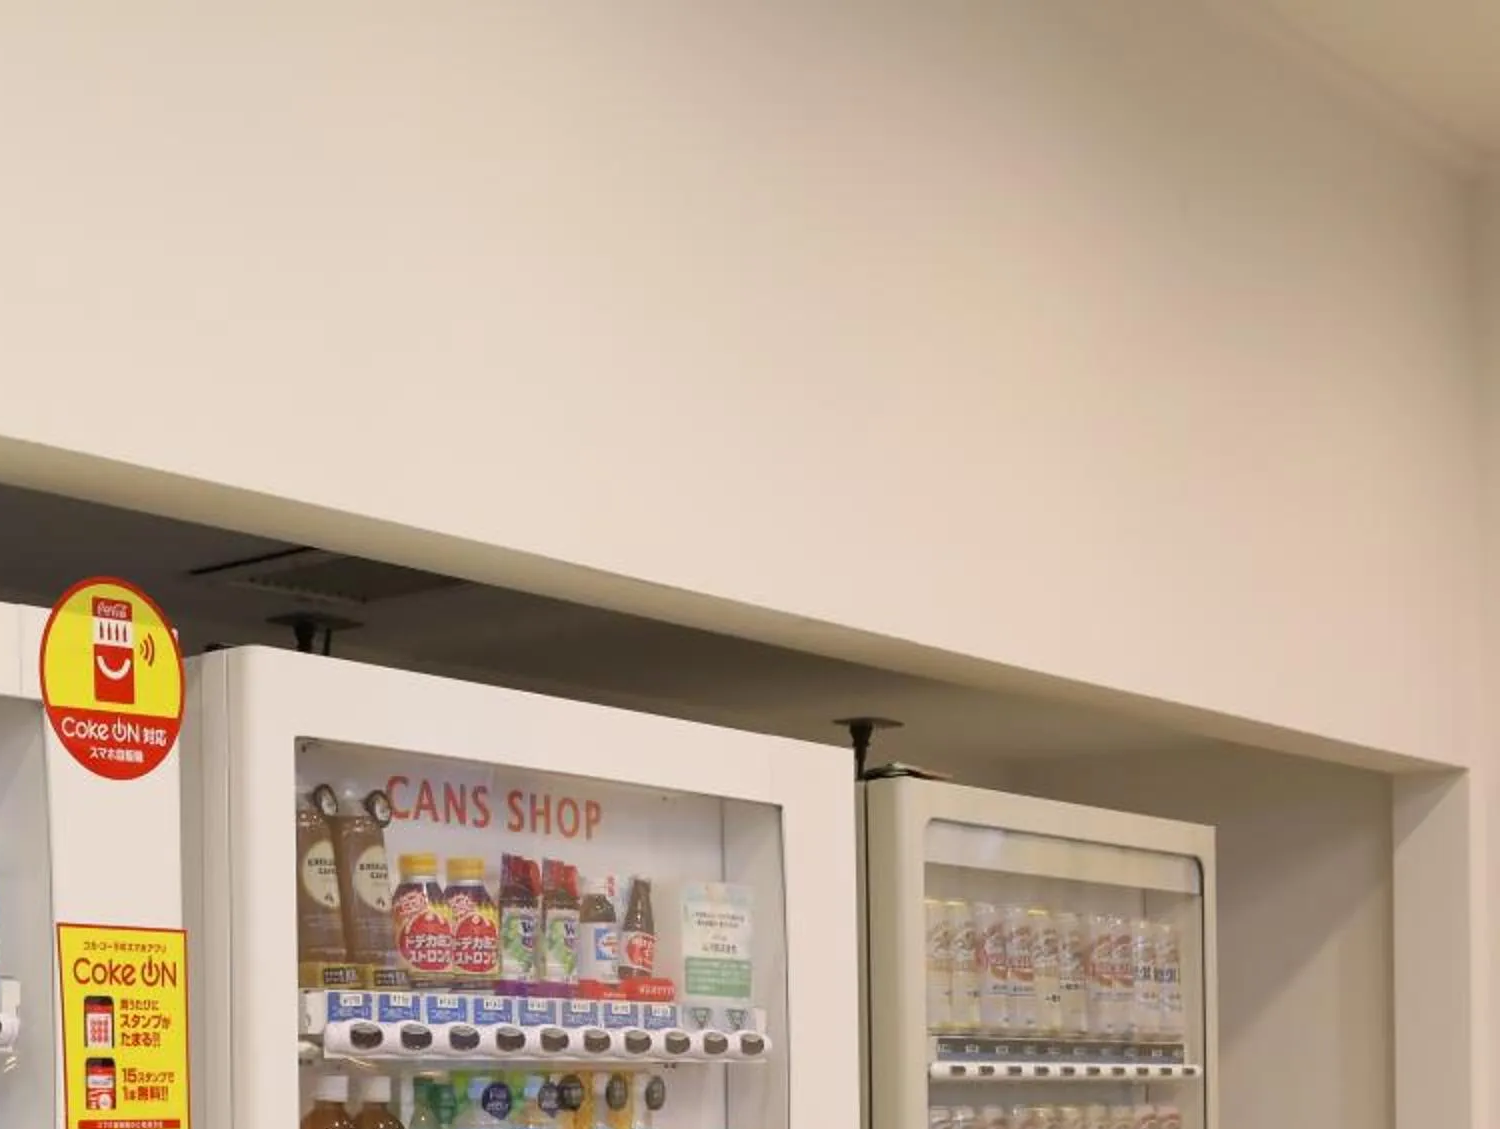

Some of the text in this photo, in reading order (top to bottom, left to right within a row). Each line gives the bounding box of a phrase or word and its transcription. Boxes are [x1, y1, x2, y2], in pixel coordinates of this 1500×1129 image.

[61, 716, 109, 741] Coke
[386, 775, 602, 840] CANS SHOP
[73, 957, 136, 986] Coke
